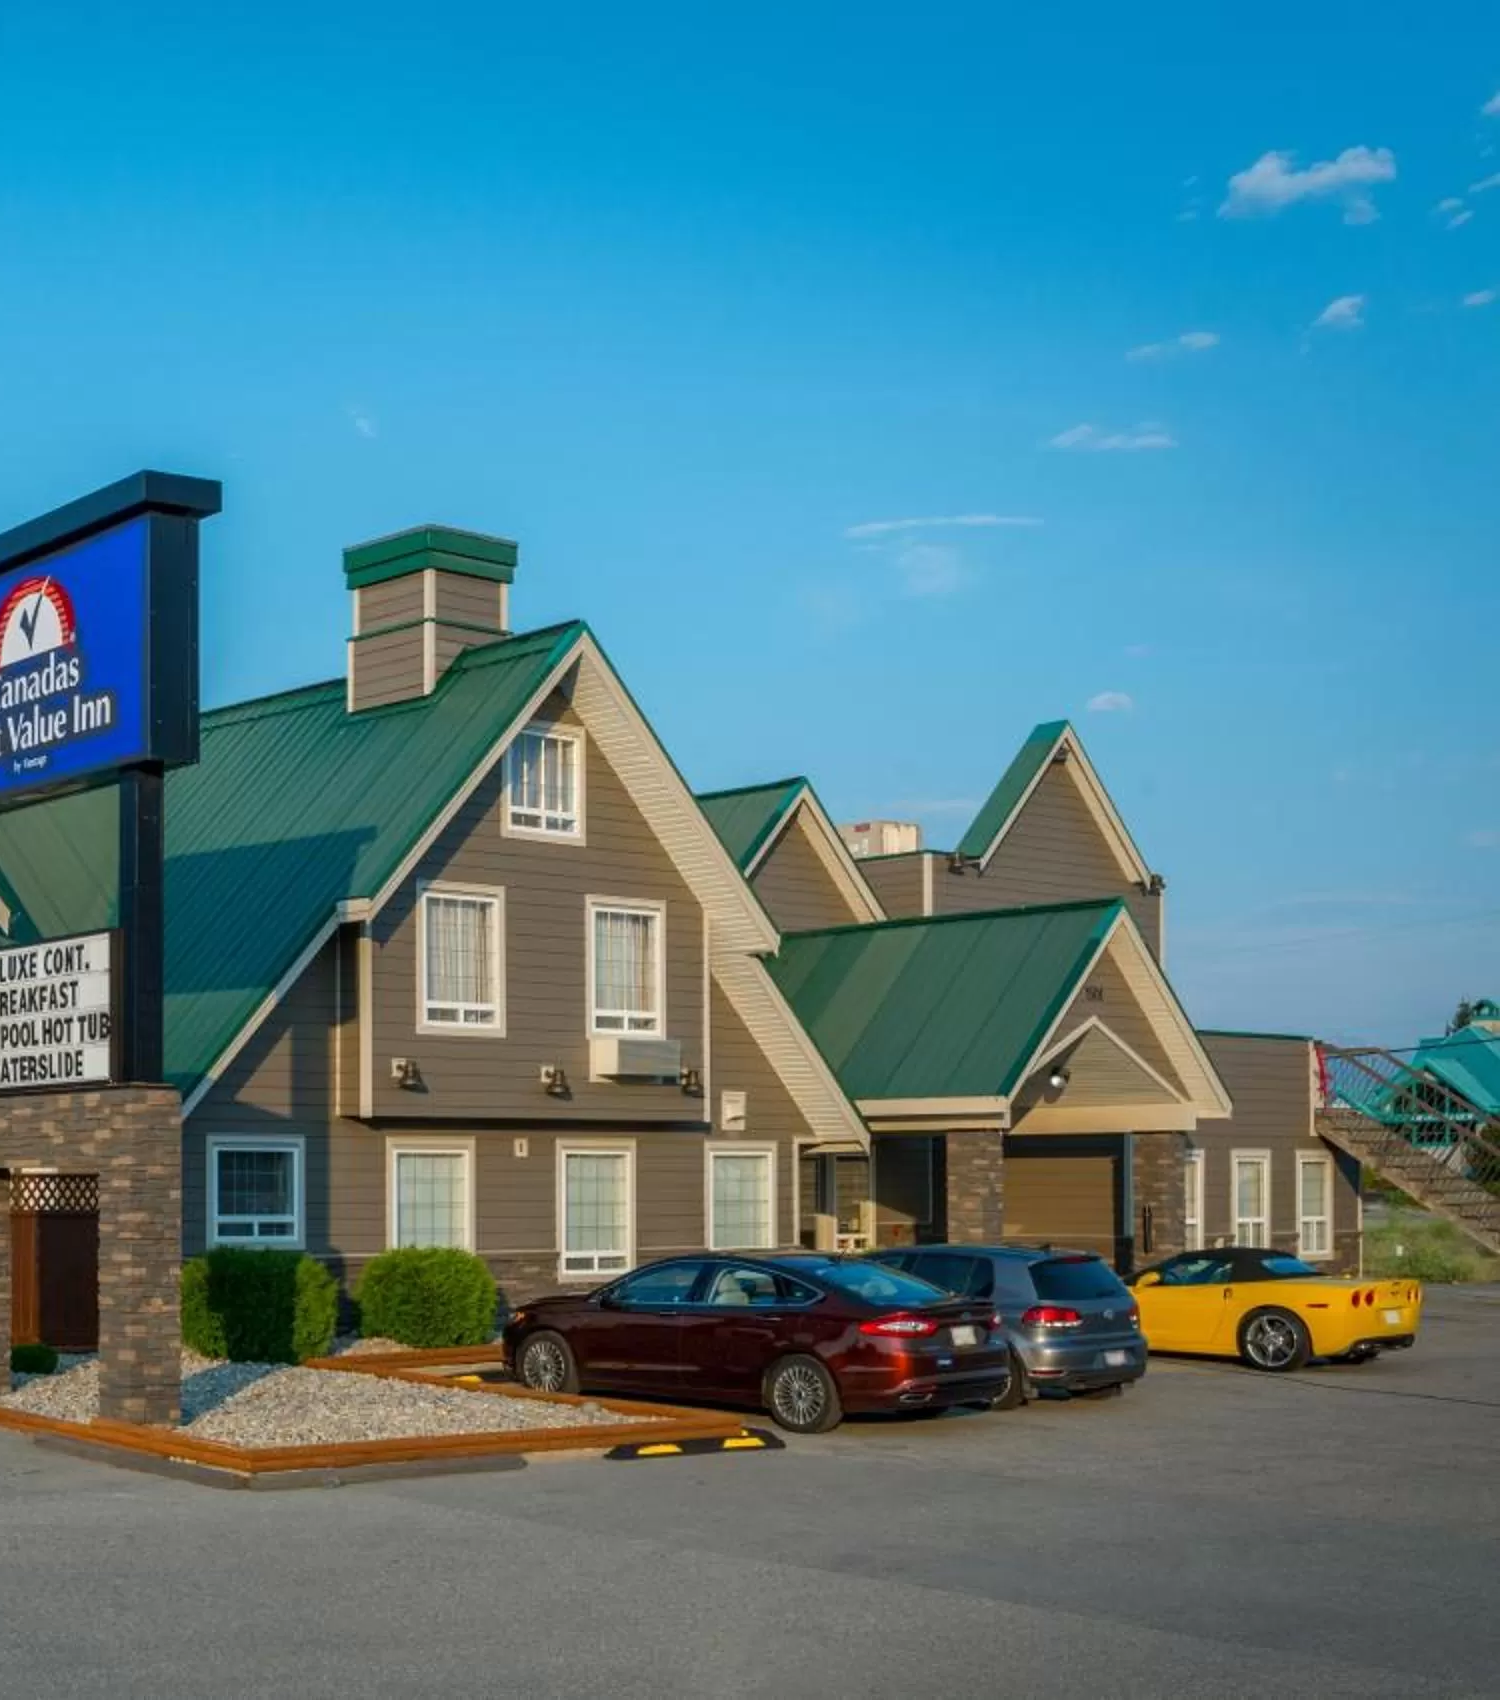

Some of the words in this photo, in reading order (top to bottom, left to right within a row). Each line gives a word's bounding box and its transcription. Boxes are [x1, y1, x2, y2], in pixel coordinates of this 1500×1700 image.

[7, 705, 67, 752] Value
[73, 695, 112, 733] Inn
[44, 944, 90, 976] CONT.
[1, 1019, 39, 1048] POOL
[42, 1017, 74, 1045] HOT
[77, 1012, 111, 1043] TUB
